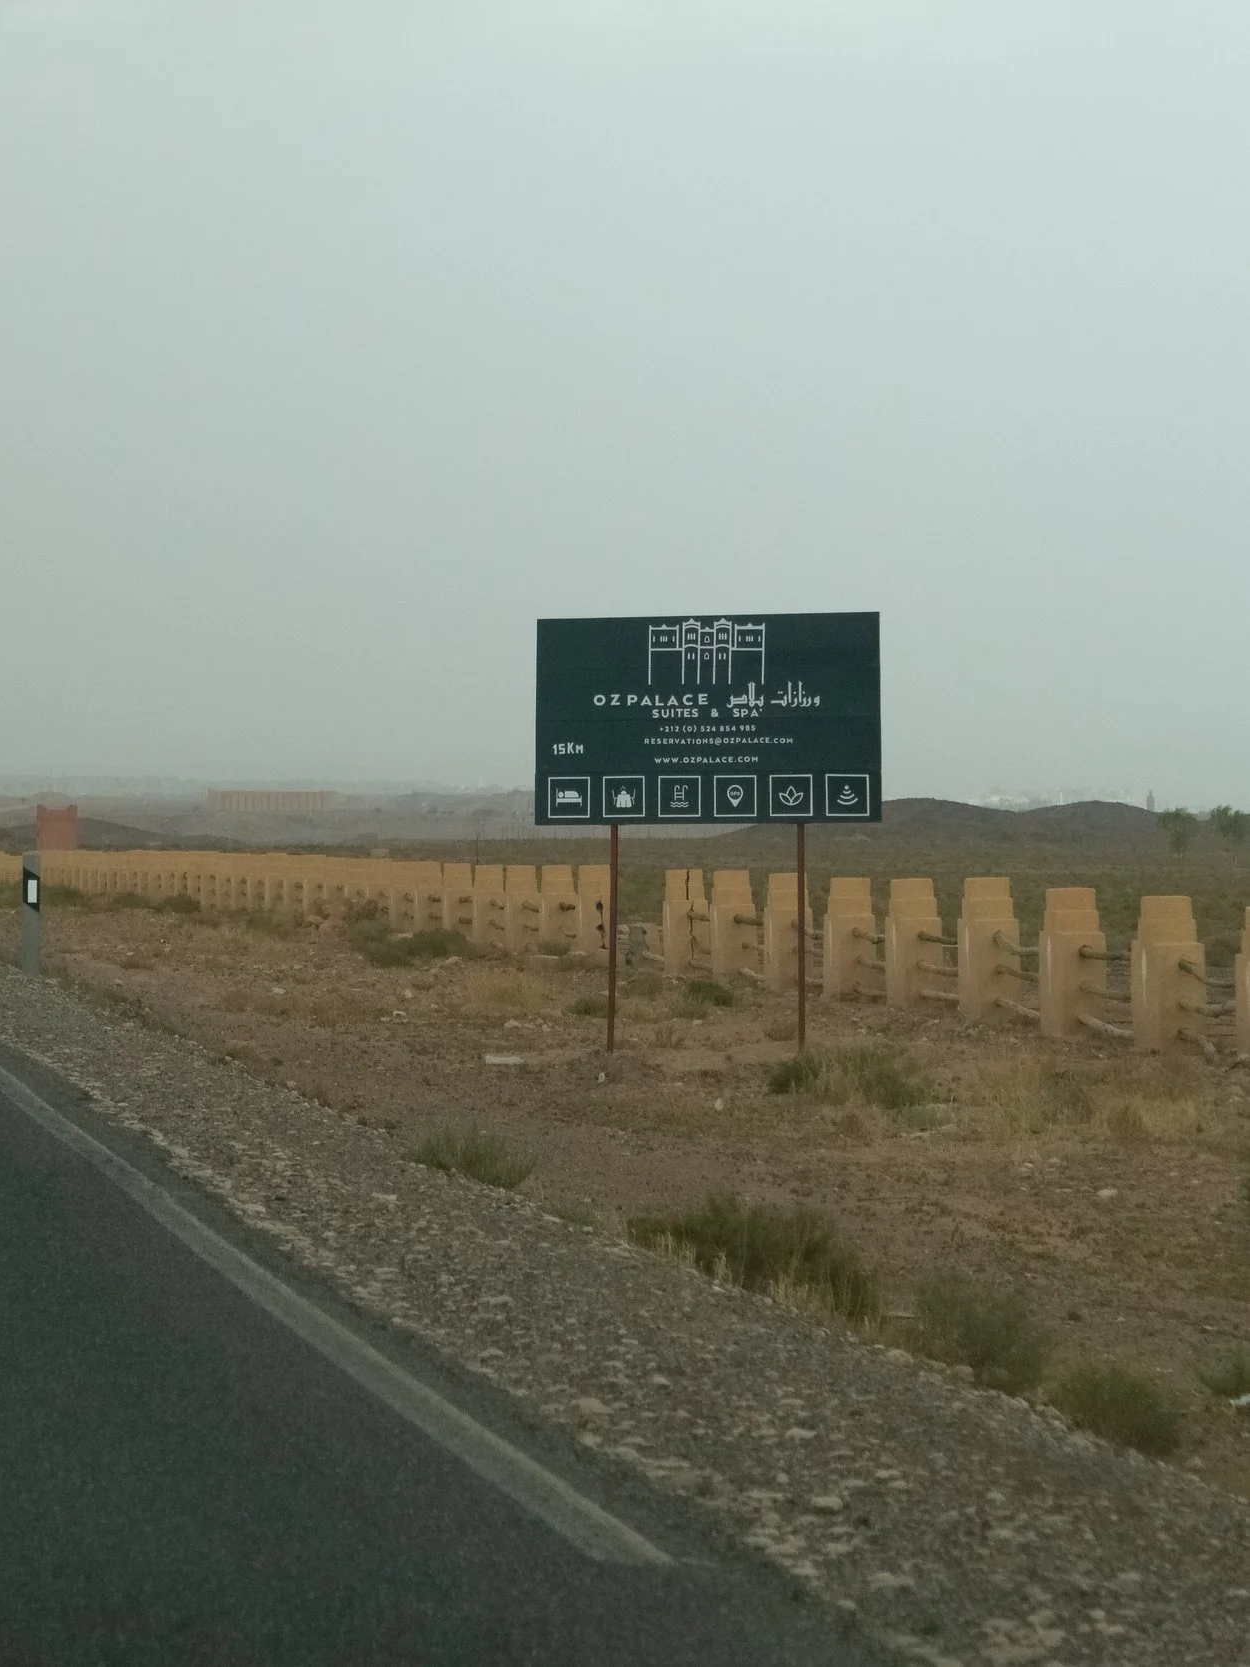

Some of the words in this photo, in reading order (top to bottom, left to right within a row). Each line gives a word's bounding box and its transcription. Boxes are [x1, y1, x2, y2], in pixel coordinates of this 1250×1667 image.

[770, 680, 821, 709] ورزازات
[651, 708, 699, 719] SUITES
[710, 708, 720, 718] &
[732, 708, 759, 718] SPA
[659, 725, 680, 733] +212
[682, 725, 697, 733] (0)
[700, 725, 717, 733] 524
[719, 725, 737, 733] 854
[739, 724, 756, 732] 985
[644, 737, 794, 746] RESERVATIONS@OZPALACE.COM
[654, 755, 759, 764] WWW.OZPALACE.COM
